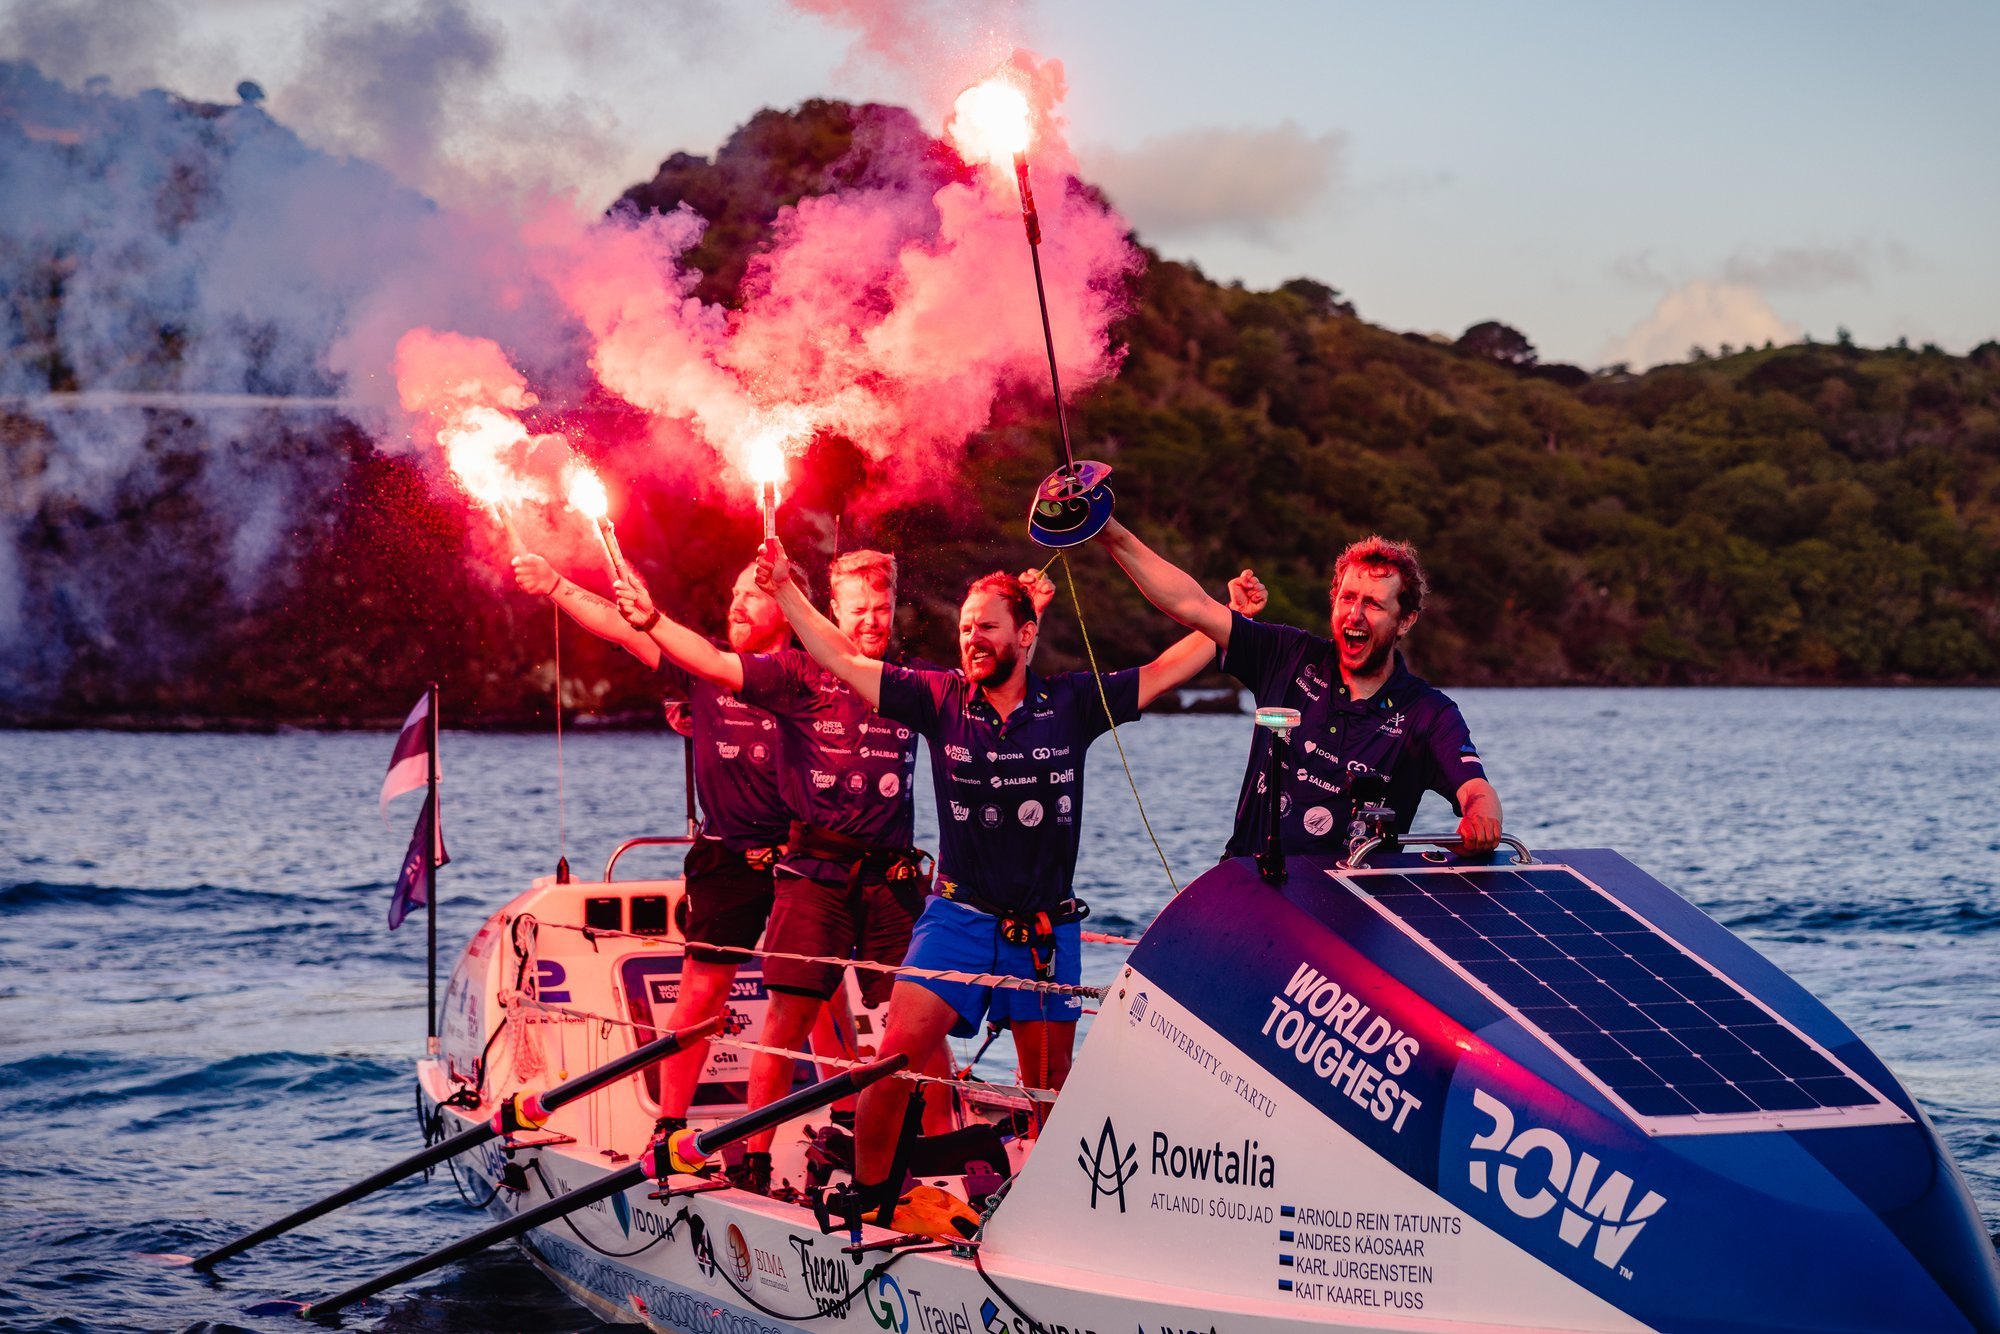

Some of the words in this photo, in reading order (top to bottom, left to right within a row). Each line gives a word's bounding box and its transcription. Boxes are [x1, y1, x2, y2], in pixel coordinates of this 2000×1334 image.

[868, 726, 891, 735] IDONA
[871, 750, 898, 759] SALIBAR
[1051, 746, 1070, 757] Travel
[1315, 748, 1339, 764] IDONA
[1003, 776, 1038, 786] SALIBAR
[1050, 768, 1074, 784] Delfi
[1308, 775, 1341, 794] SALIBAR
[729, 982, 757, 996] OW
[1283, 961, 1420, 1076] WORLD'S
[713, 1052, 738, 1063] Gill
[1150, 1010, 1221, 1075] UNIVERSITY
[1220, 1070, 1233, 1086] OF
[1234, 1076, 1277, 1118] TARTU
[1261, 996, 1422, 1133] TOUGHEST
[1151, 1131, 1275, 1189] Rowtalia
[1470, 1088, 1667, 1270] ROW
[1151, 1192, 1204, 1215] ATLANDI
[1209, 1197, 1274, 1224] SÕUDJAD
[1297, 1208, 1352, 1229] ARNOLD
[1356, 1212, 1389, 1231] REIN
[1394, 1214, 1461, 1235] TATUNTS
[632, 1206, 675, 1242] IDONA
[1296, 1232, 1351, 1253] ANDRES
[1355, 1235, 1425, 1257] KÄOSAAR
[754, 1248, 787, 1278] BIMA
[789, 1234, 850, 1303] Freezy
[1296, 1256, 1329, 1276] KARL
[1333, 1258, 1433, 1284] JÜRGENSTEIN
[1295, 1282, 1323, 1301] KAIT
[1327, 1285, 1380, 1307] KAAREL
[1384, 1290, 1424, 1310] PUSS
[908, 1289, 972, 1334] Travel
